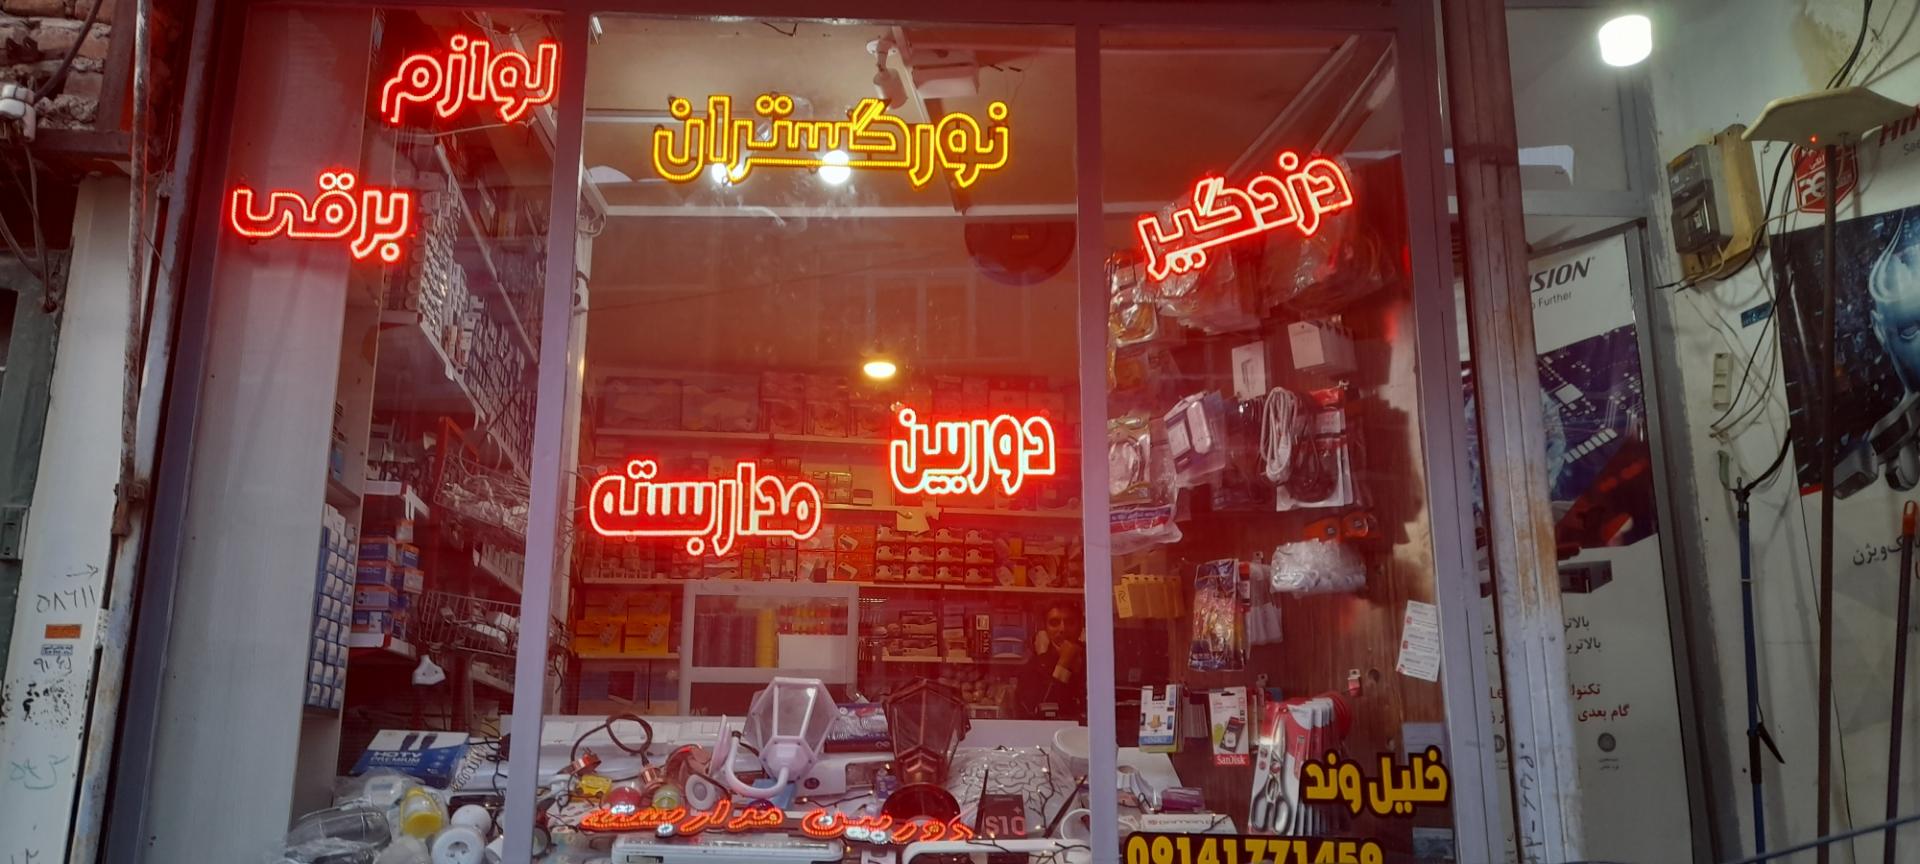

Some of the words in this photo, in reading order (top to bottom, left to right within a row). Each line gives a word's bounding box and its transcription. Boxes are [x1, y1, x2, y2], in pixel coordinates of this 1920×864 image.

[381, 34, 557, 123] لوازم
[232, 173, 409, 262] برقی
[1138, 152, 1353, 280] دزدگیر
[1539, 291, 1572, 308] Further
[890, 407, 1056, 495] دوربین
[589, 460, 821, 557] مداربسته
[1577, 709, 1607, 722] بعدی
[1215, 755, 1246, 766] SanDisk
[1306, 753, 1362, 814] وند
[1369, 750, 1448, 815] خلیل
